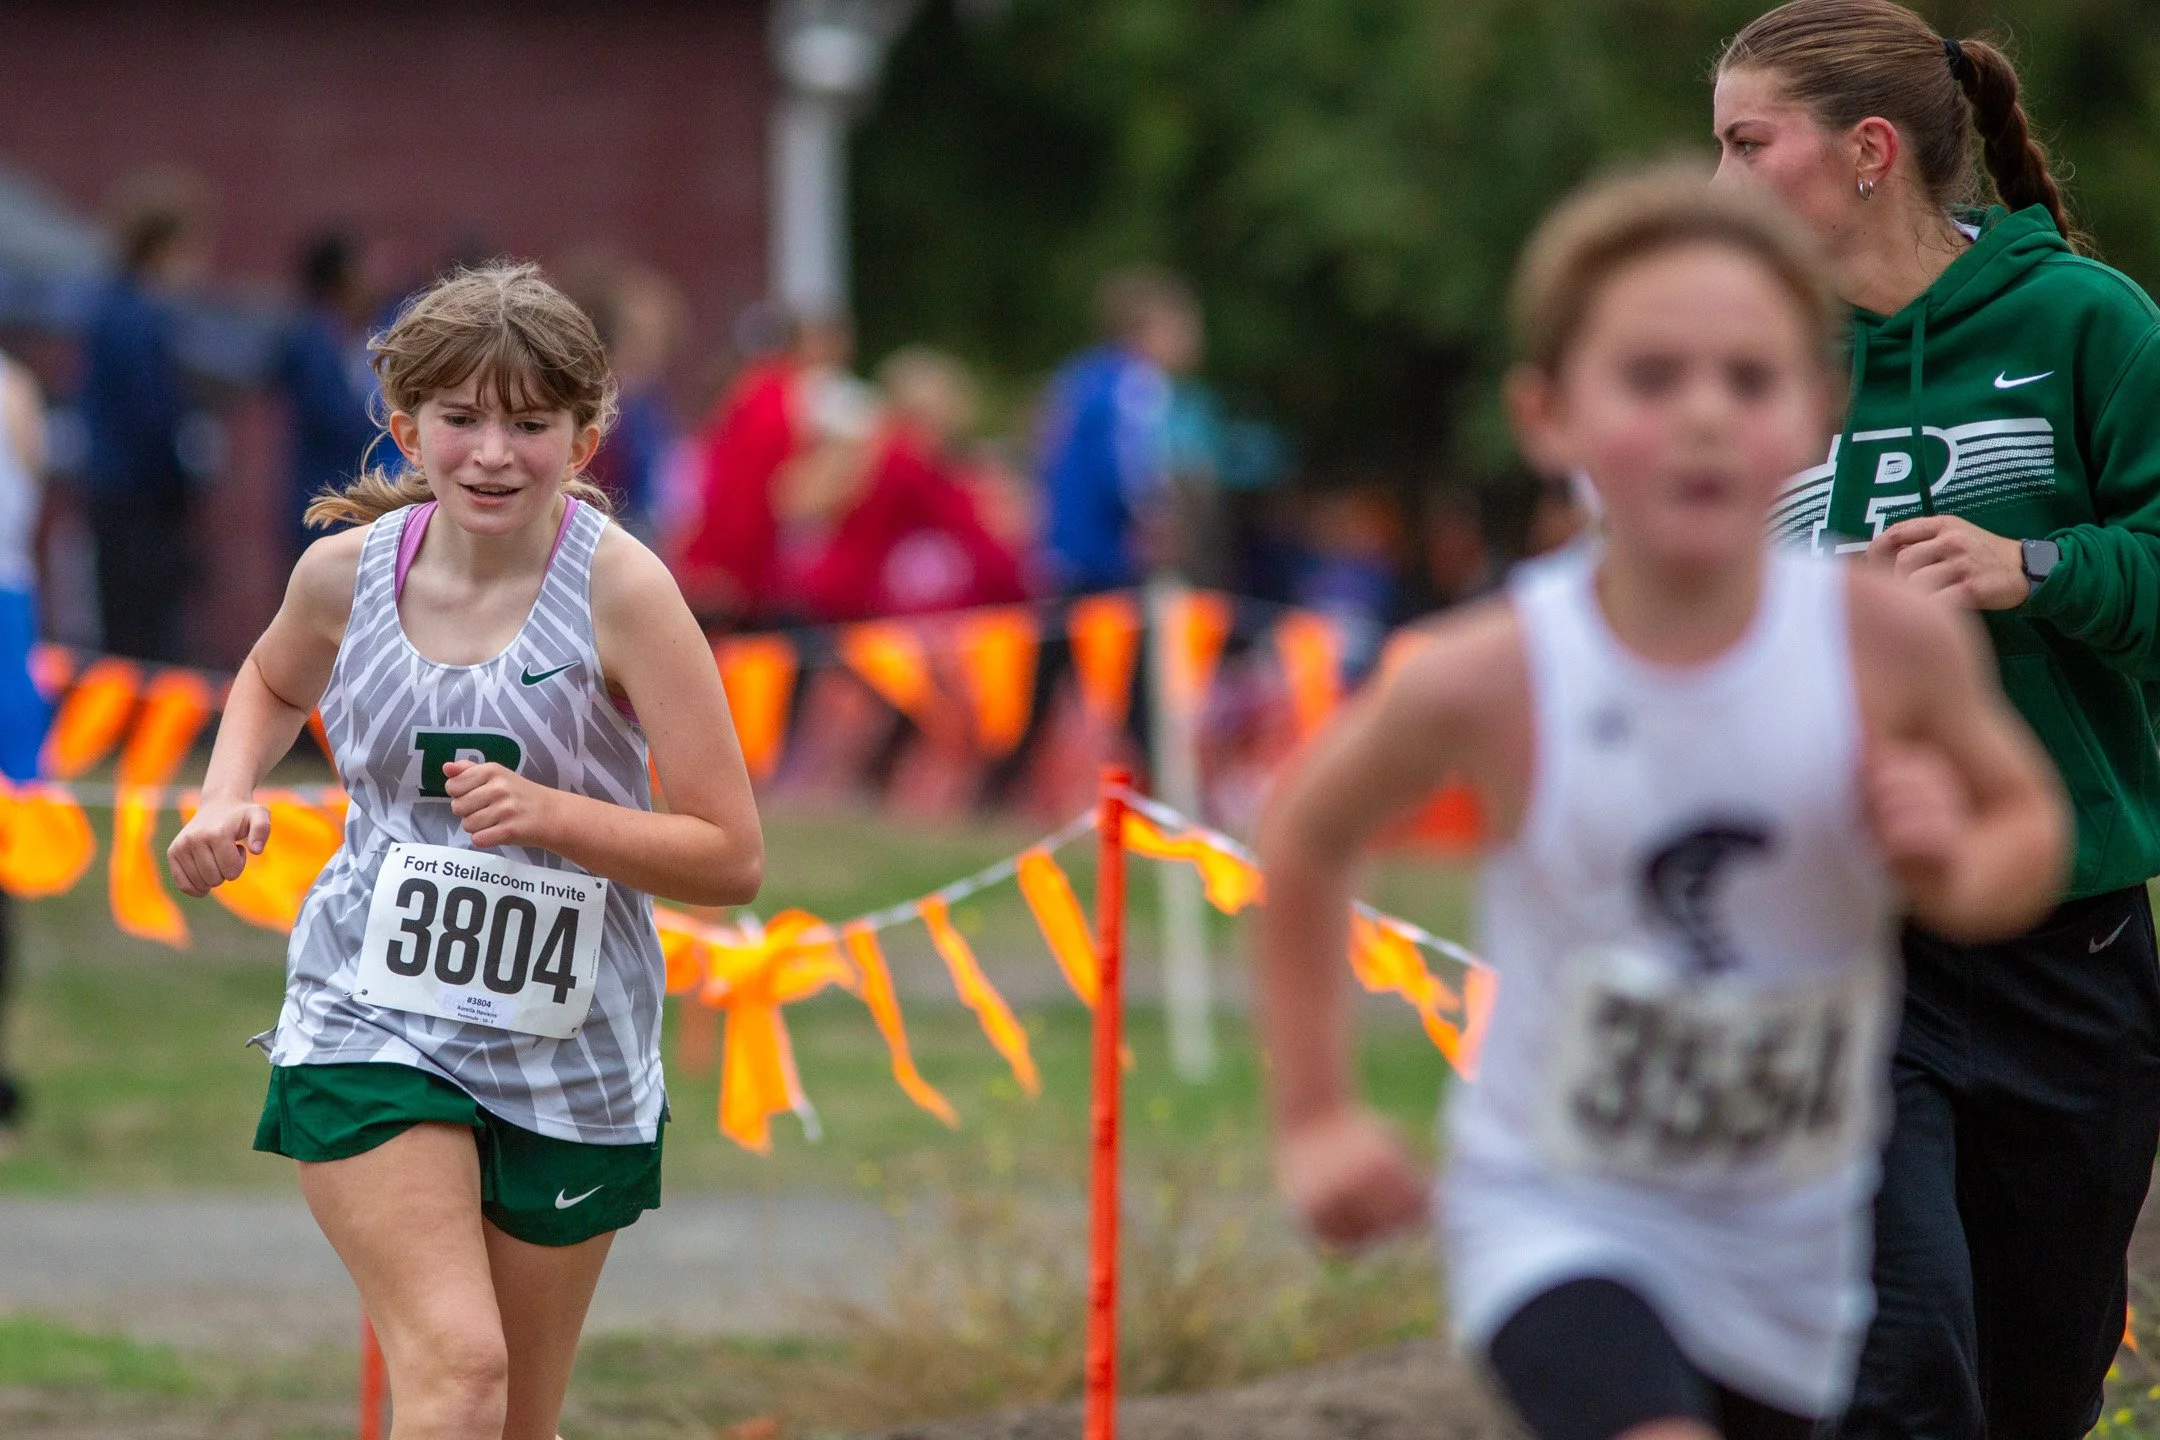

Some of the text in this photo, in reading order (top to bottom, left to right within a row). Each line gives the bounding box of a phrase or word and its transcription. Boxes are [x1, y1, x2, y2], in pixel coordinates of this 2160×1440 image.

[403, 855, 586, 902] Fort Steilacoom Invite
[386, 877, 580, 1005] 3804
[466, 996, 492, 1008] #3804
